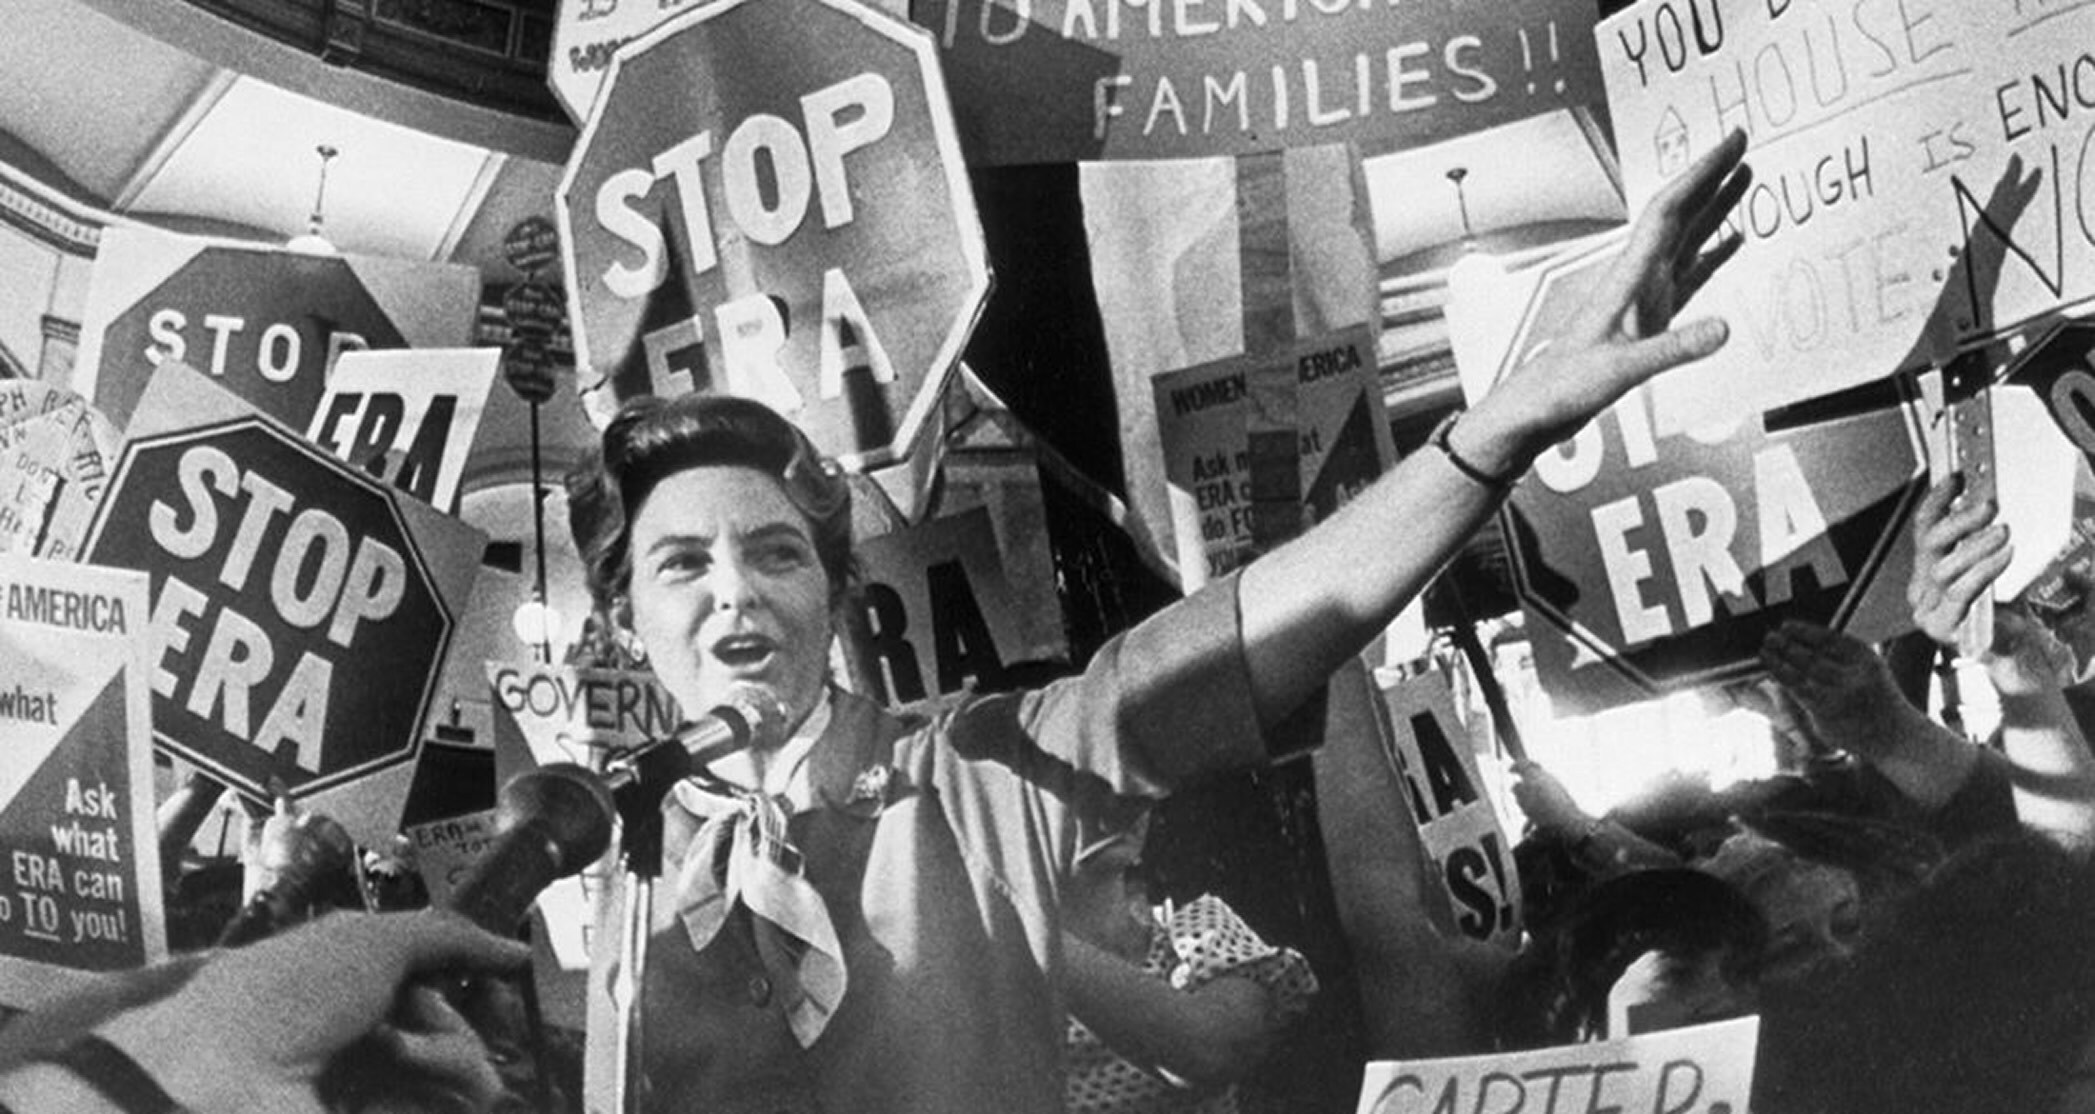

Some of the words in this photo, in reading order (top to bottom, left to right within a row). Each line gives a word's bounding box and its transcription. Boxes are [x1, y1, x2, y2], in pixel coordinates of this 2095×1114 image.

[1618, 0, 1724, 87] YOU
[1709, 0, 1954, 144] HOUSE
[1918, 121, 1976, 174] IS
[597, 72, 894, 298] STOP
[643, 267, 899, 410] ERA
[1170, 372, 1247, 417] WOMEN
[1299, 343, 1363, 385] ERICA
[316, 392, 458, 503] ERA
[1194, 449, 1230, 483] Ask
[1197, 478, 1235, 513] ERA
[1204, 511, 1227, 541] do
[149, 445, 406, 648] STOP
[1590, 440, 1849, 645] ERA
[7, 583, 126, 635] AMERICA
[852, 556, 1003, 706] RA
[150, 575, 334, 775] ERA
[65, 778, 117, 820] Ask
[13, 850, 65, 893] ERA
[75, 870, 123, 900] can
[52, 822, 120, 862] what
[19, 892, 59, 935] TO
[71, 908, 128, 944] you!
